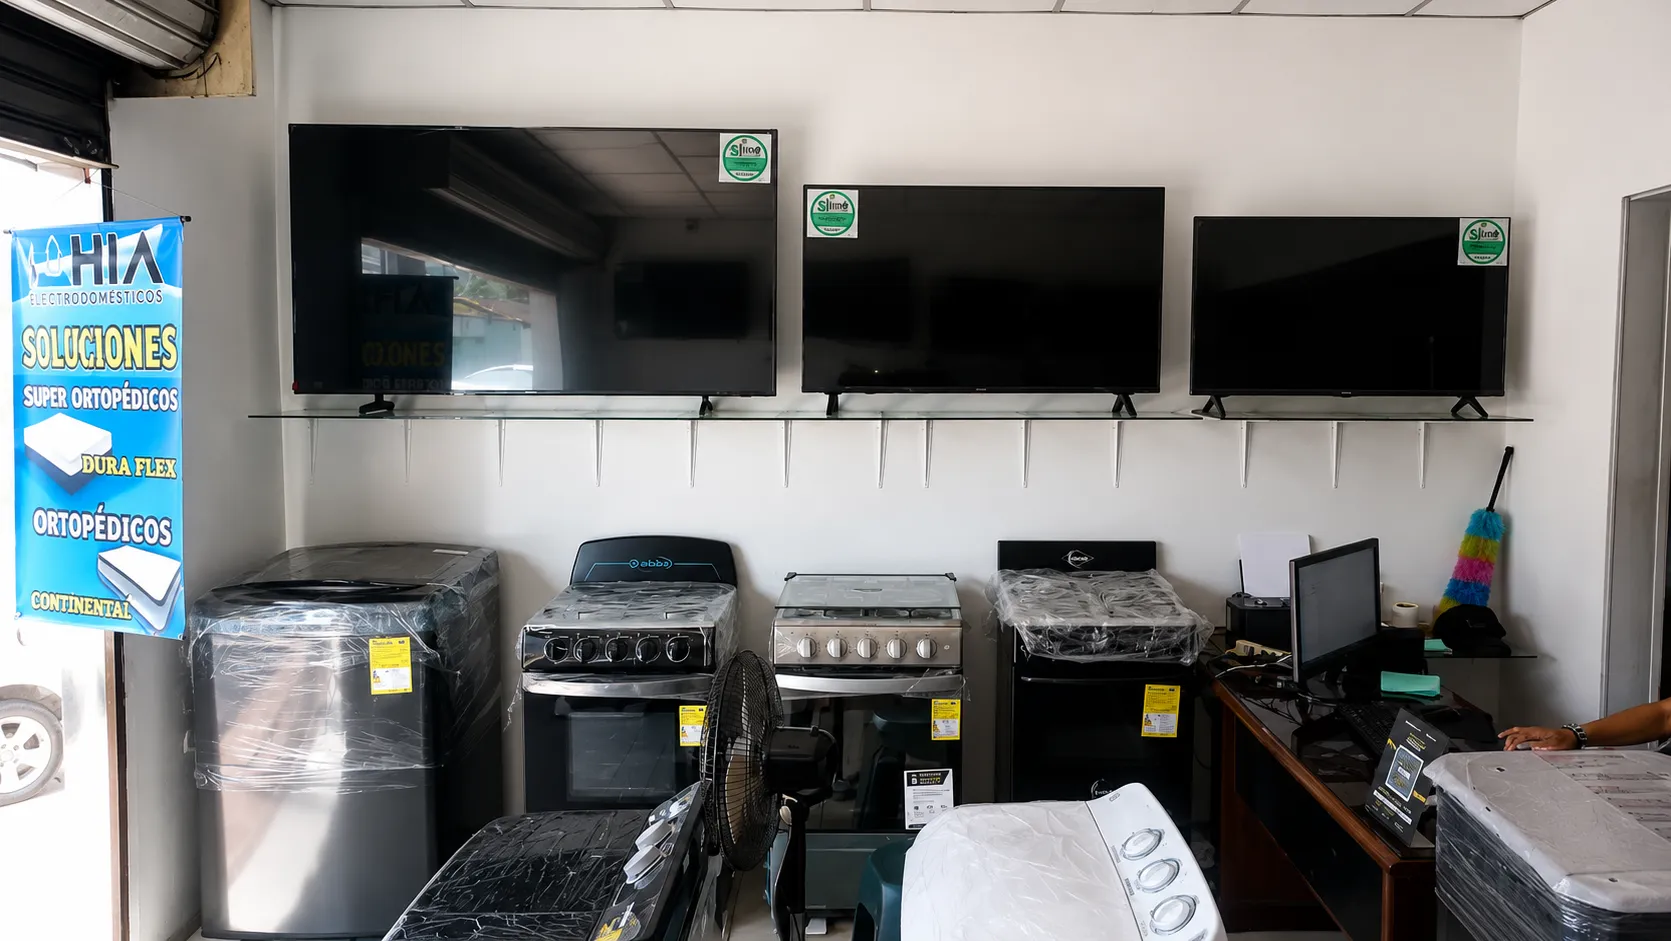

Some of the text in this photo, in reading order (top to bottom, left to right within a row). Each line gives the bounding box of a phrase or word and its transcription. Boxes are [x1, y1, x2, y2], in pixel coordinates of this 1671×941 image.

[29, 289, 163, 306] ELECTRODOMÉSTICOS
[22, 324, 178, 371] SOLUCIONES
[23, 380, 179, 412] SUPER ORTOPÉDICOS
[81, 454, 177, 479] DURA FLEX
[32, 502, 173, 546] ORTOPÉDICOS
[30, 590, 132, 620] CONTINENTAL
